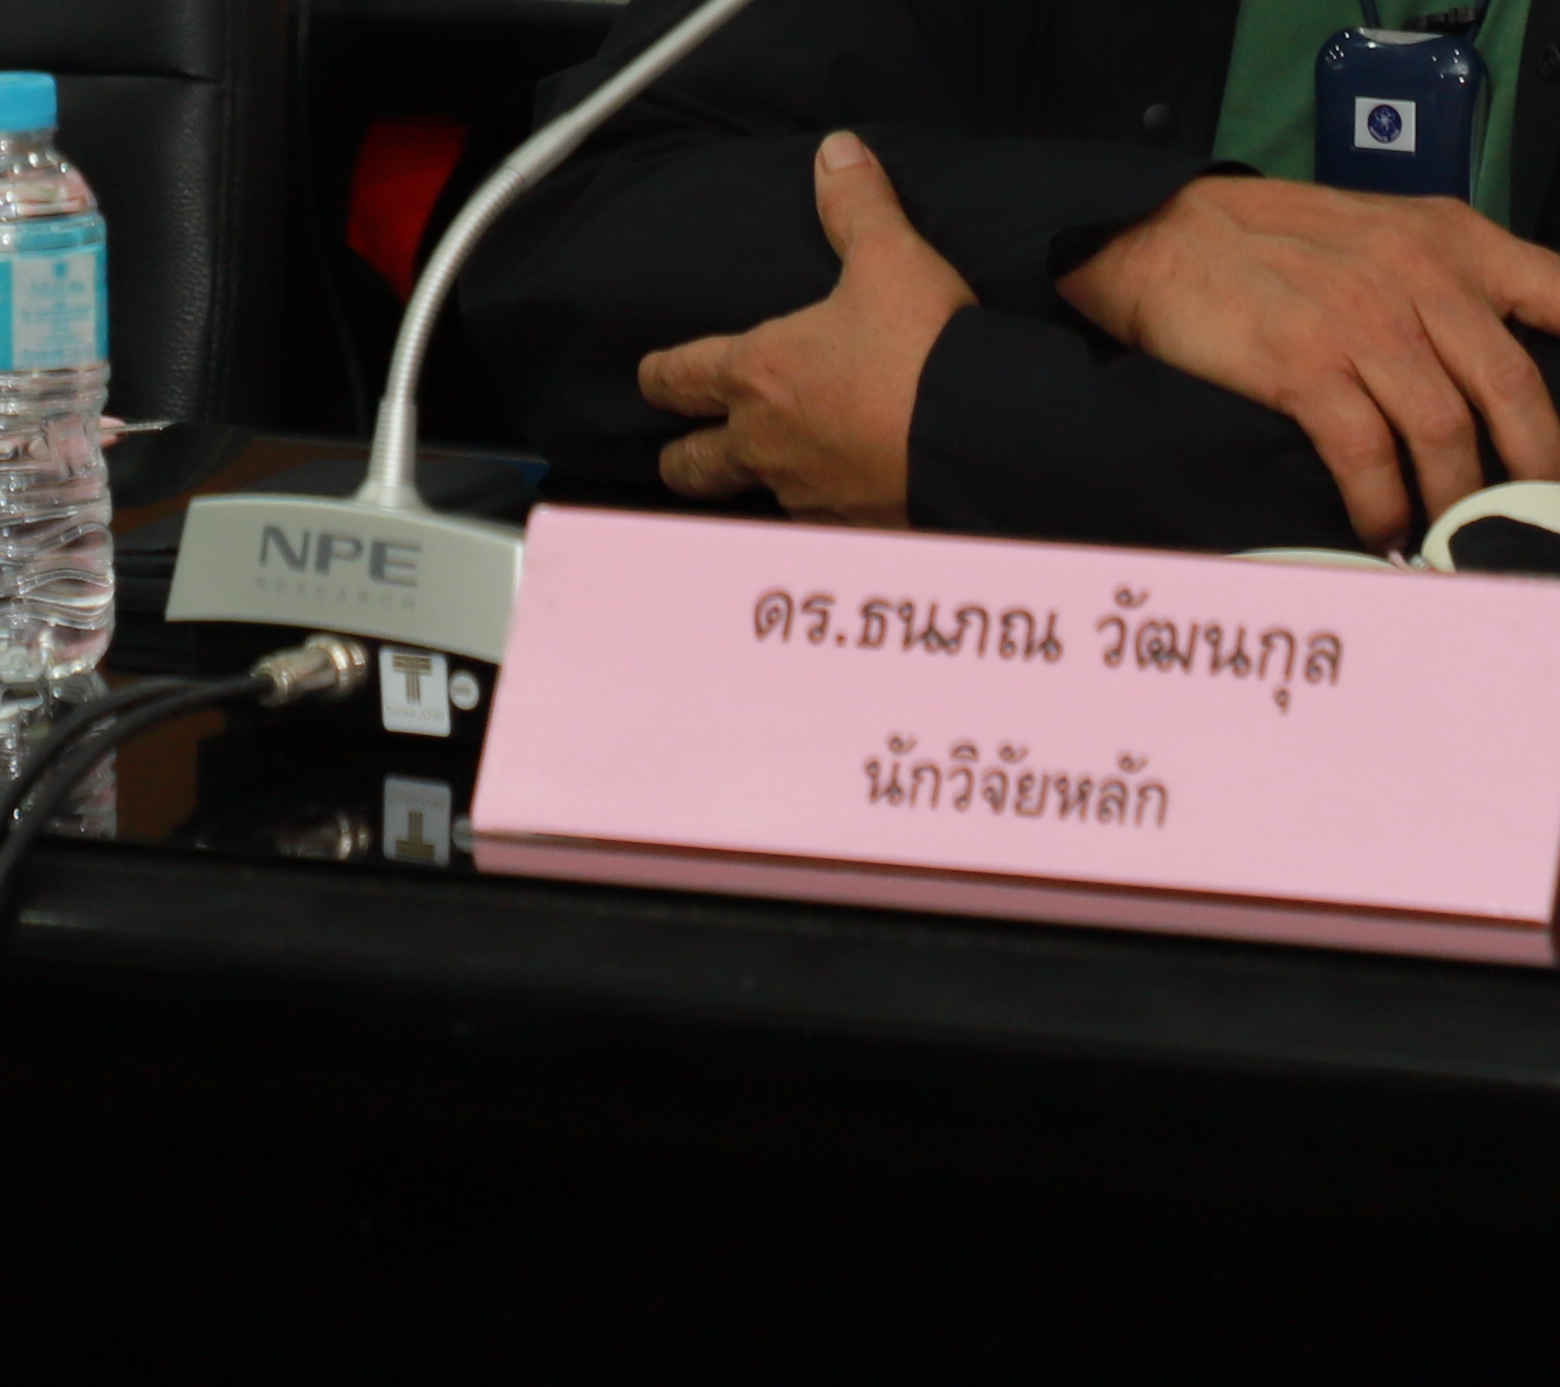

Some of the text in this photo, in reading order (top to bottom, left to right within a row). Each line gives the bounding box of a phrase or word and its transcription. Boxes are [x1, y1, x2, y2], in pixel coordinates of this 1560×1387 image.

[258, 523, 423, 589] NPE
[751, 586, 1345, 712] ดร.ธนภณ วัฒนกุล
[863, 732, 1171, 829] นักวิจัยหลัก
